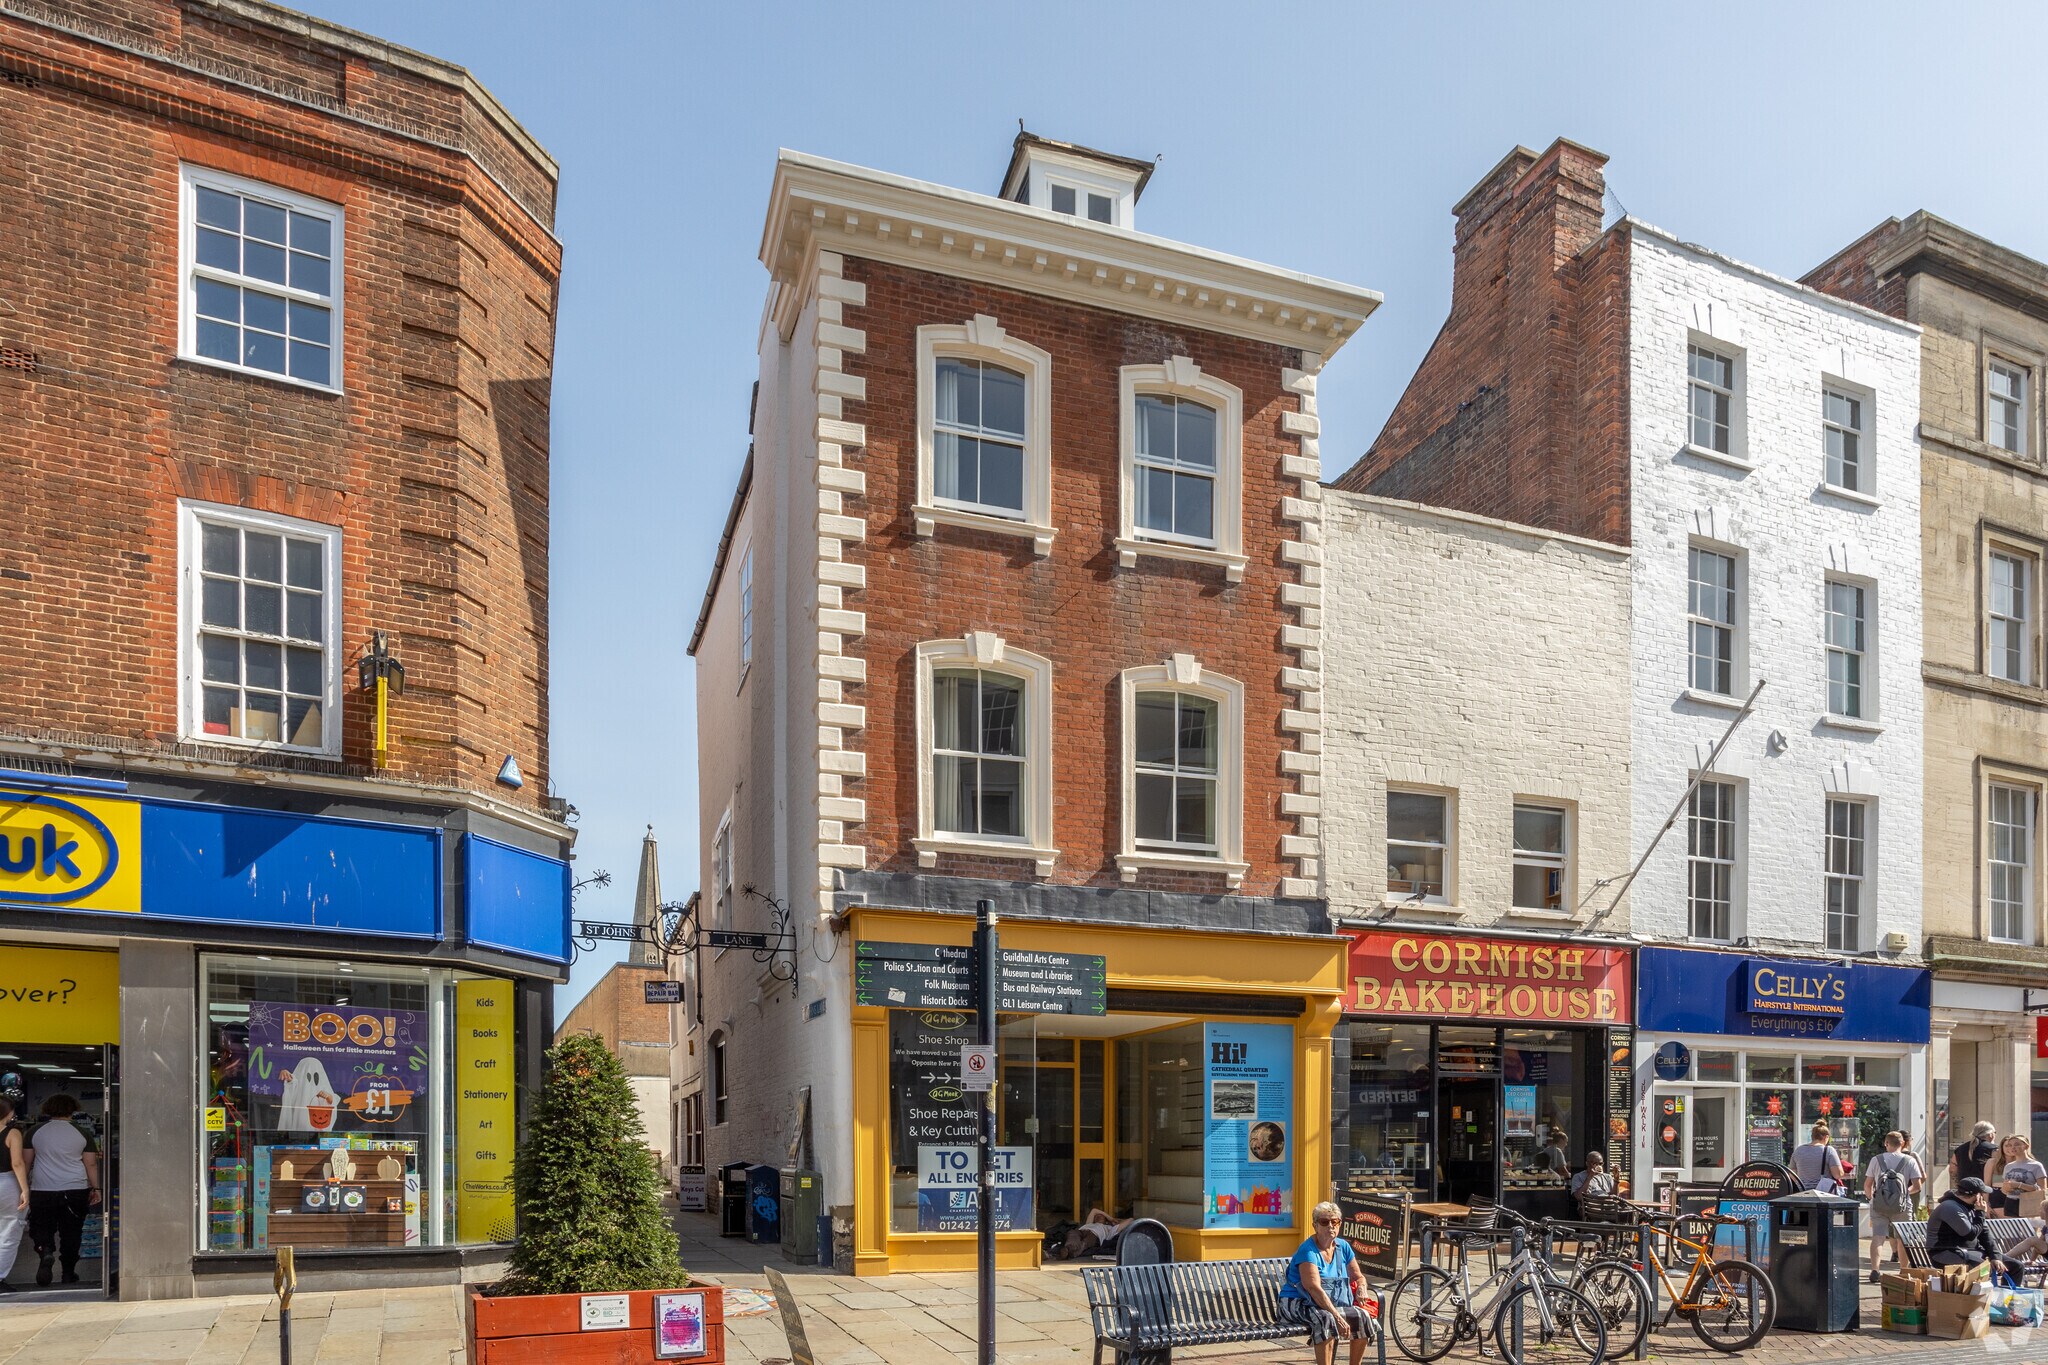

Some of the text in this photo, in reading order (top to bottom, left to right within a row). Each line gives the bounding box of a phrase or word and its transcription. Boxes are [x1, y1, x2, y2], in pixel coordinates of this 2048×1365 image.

[586, 925, 600, 935] ST
[724, 935, 753, 945] LANE
[935, 947, 968, 959] Cthedral
[1002, 952, 1070, 965] Guildhall Arts Centre
[1391, 938, 1585, 982] CORNISH
[884, 961, 969, 975] Police Sttion and Courts
[1002, 968, 1073, 981] Museum and Libraries
[924, 979, 970, 991] Folk Museum
[1003, 982, 1082, 996] Bus and Railway Stations
[1754, 968, 1845, 1000] CELLY'S
[476, 998, 495, 1007] Kids
[921, 993, 968, 1006] Historic Docks
[1002, 998, 1063, 1011] GL1 Leisure Centre
[1353, 976, 1618, 1020] BAKEHOUSE
[1754, 999, 1845, 1013] HAIRSTYLE INTERNATIONAL
[283, 1010, 397, 1048] BOO!
[1751, 1015, 1834, 1033] Everything's £16
[472, 1029, 498, 1038] Books
[919, 1034, 969, 1045] Shoe Shop
[283, 1043, 322, 1052] Halloween
[346, 1046, 363, 1054] little
[364, 1048, 397, 1056] monsters
[1211, 1042, 1248, 1065] Hi!
[474, 1059, 497, 1068] Craft
[1656, 1055, 1689, 1065] CELLY'S
[365, 1089, 393, 1115] £1
[464, 1090, 508, 1101] Stationery
[909, 1108, 978, 1121] Shoe Repairs
[479, 1120, 493, 1129] Art
[909, 1125, 978, 1138] & Key Cuttin
[475, 1151, 497, 1160] Gifts
[935, 1151, 969, 1170] TO
[928, 1172, 952, 1183] ALL
[1733, 1178, 1781, 1189] BAKEHOUSE
[680, 1186, 694, 1194] Keys
[966, 1191, 1003, 1208] AH
[939, 1220, 971, 1230] 01242
[1355, 1213, 1381, 1225] CORNISH
[1342, 1221, 1392, 1245] BAKEHOUSE
[1353, 1241, 1369, 1253] SINCE
[1361, 1261, 1382, 1269] THROUGHOUT
